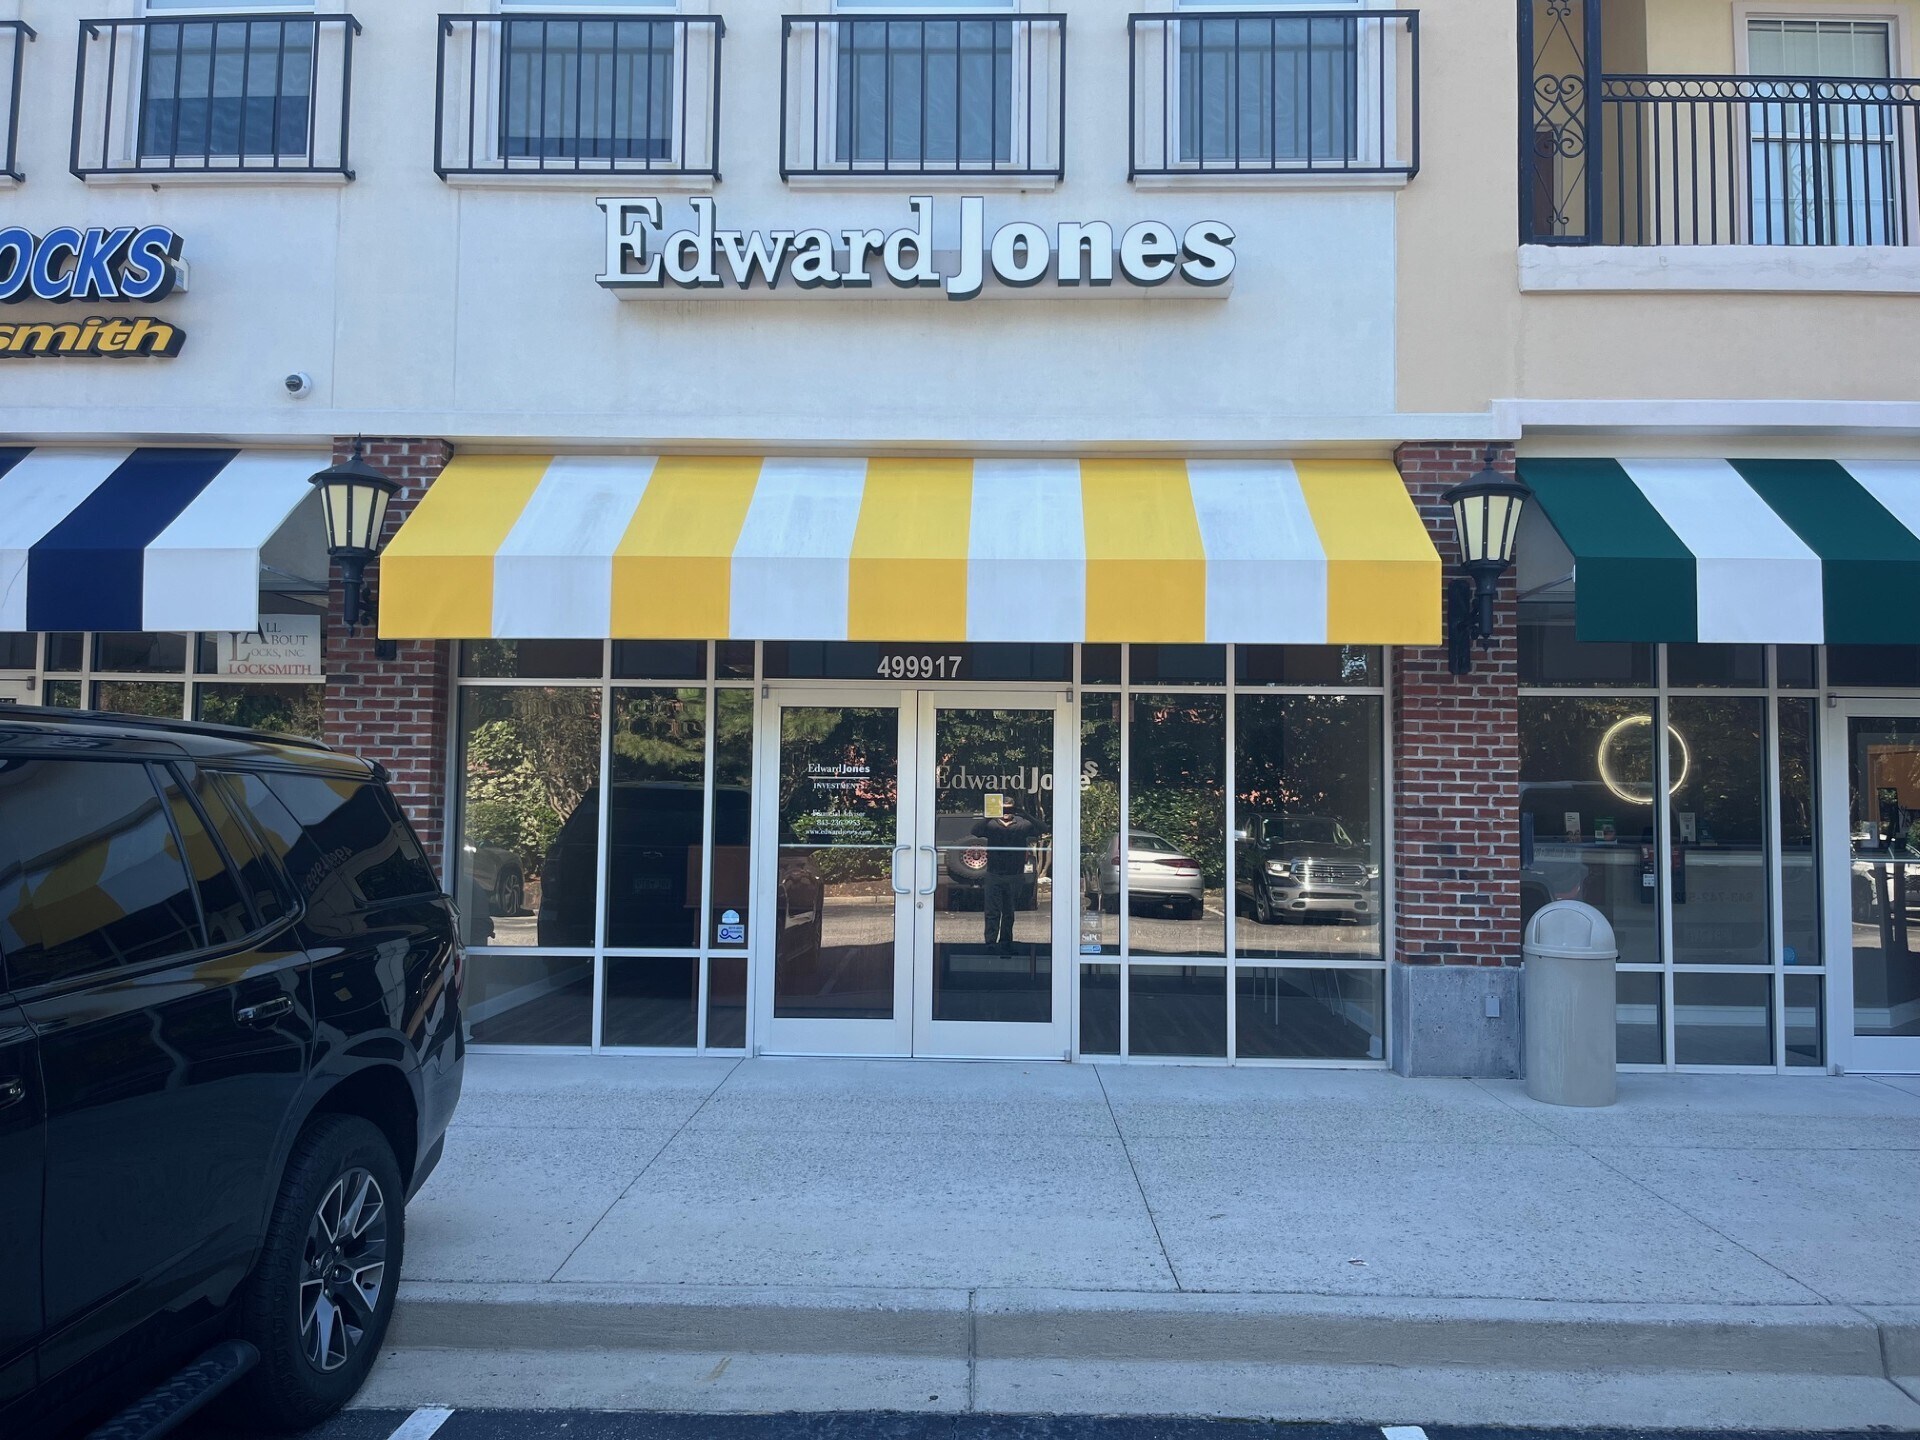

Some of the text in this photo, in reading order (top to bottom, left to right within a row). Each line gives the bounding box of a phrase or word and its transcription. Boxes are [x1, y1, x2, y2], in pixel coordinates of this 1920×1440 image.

[595, 196, 1237, 300] Edward Jones
[228, 664, 312, 676] LOCKSMITH
[877, 655, 962, 678] 499917
[808, 763, 870, 774] Edward Jones
[813, 782, 865, 790] INVESTMENTS
[936, 766, 1026, 790] Edward
